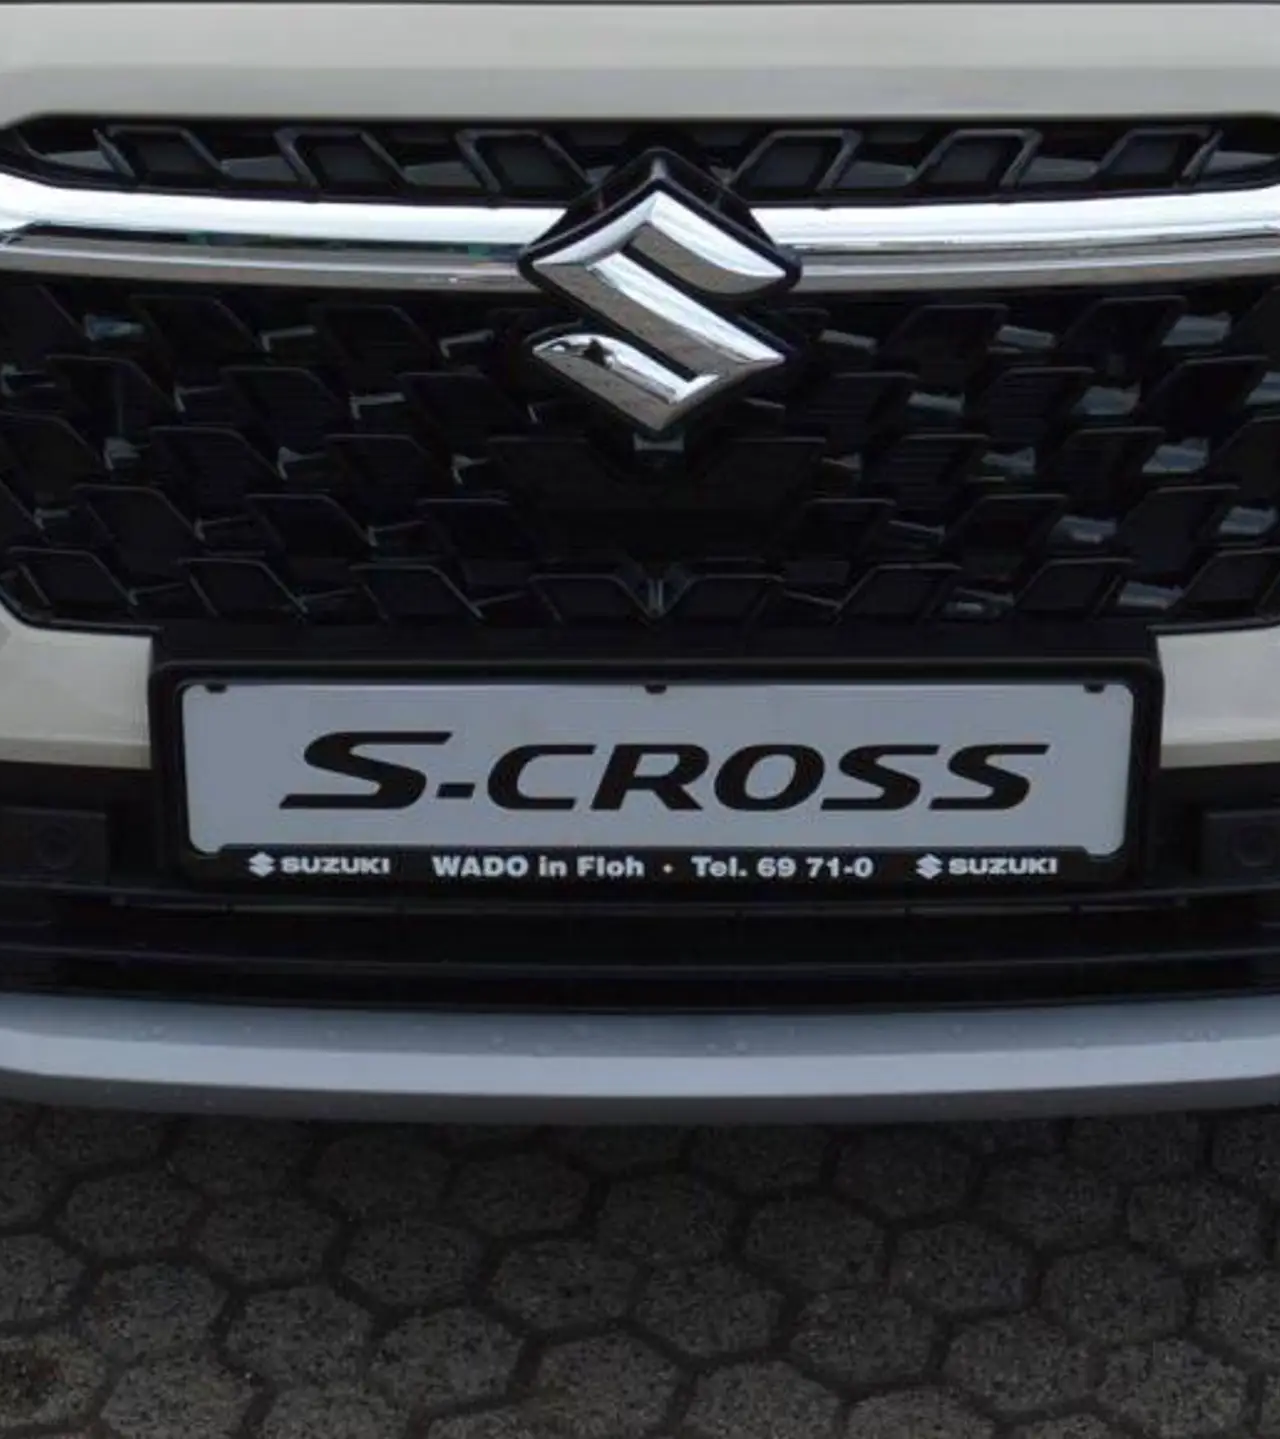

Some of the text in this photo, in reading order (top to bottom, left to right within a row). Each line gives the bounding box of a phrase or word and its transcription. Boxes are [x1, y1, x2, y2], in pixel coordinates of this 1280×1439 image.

[278, 730, 1050, 813] S-CROSS
[280, 854, 1058, 878] SUZUKI WADO in Floh Tel. 69 71-0 SUZUKI
